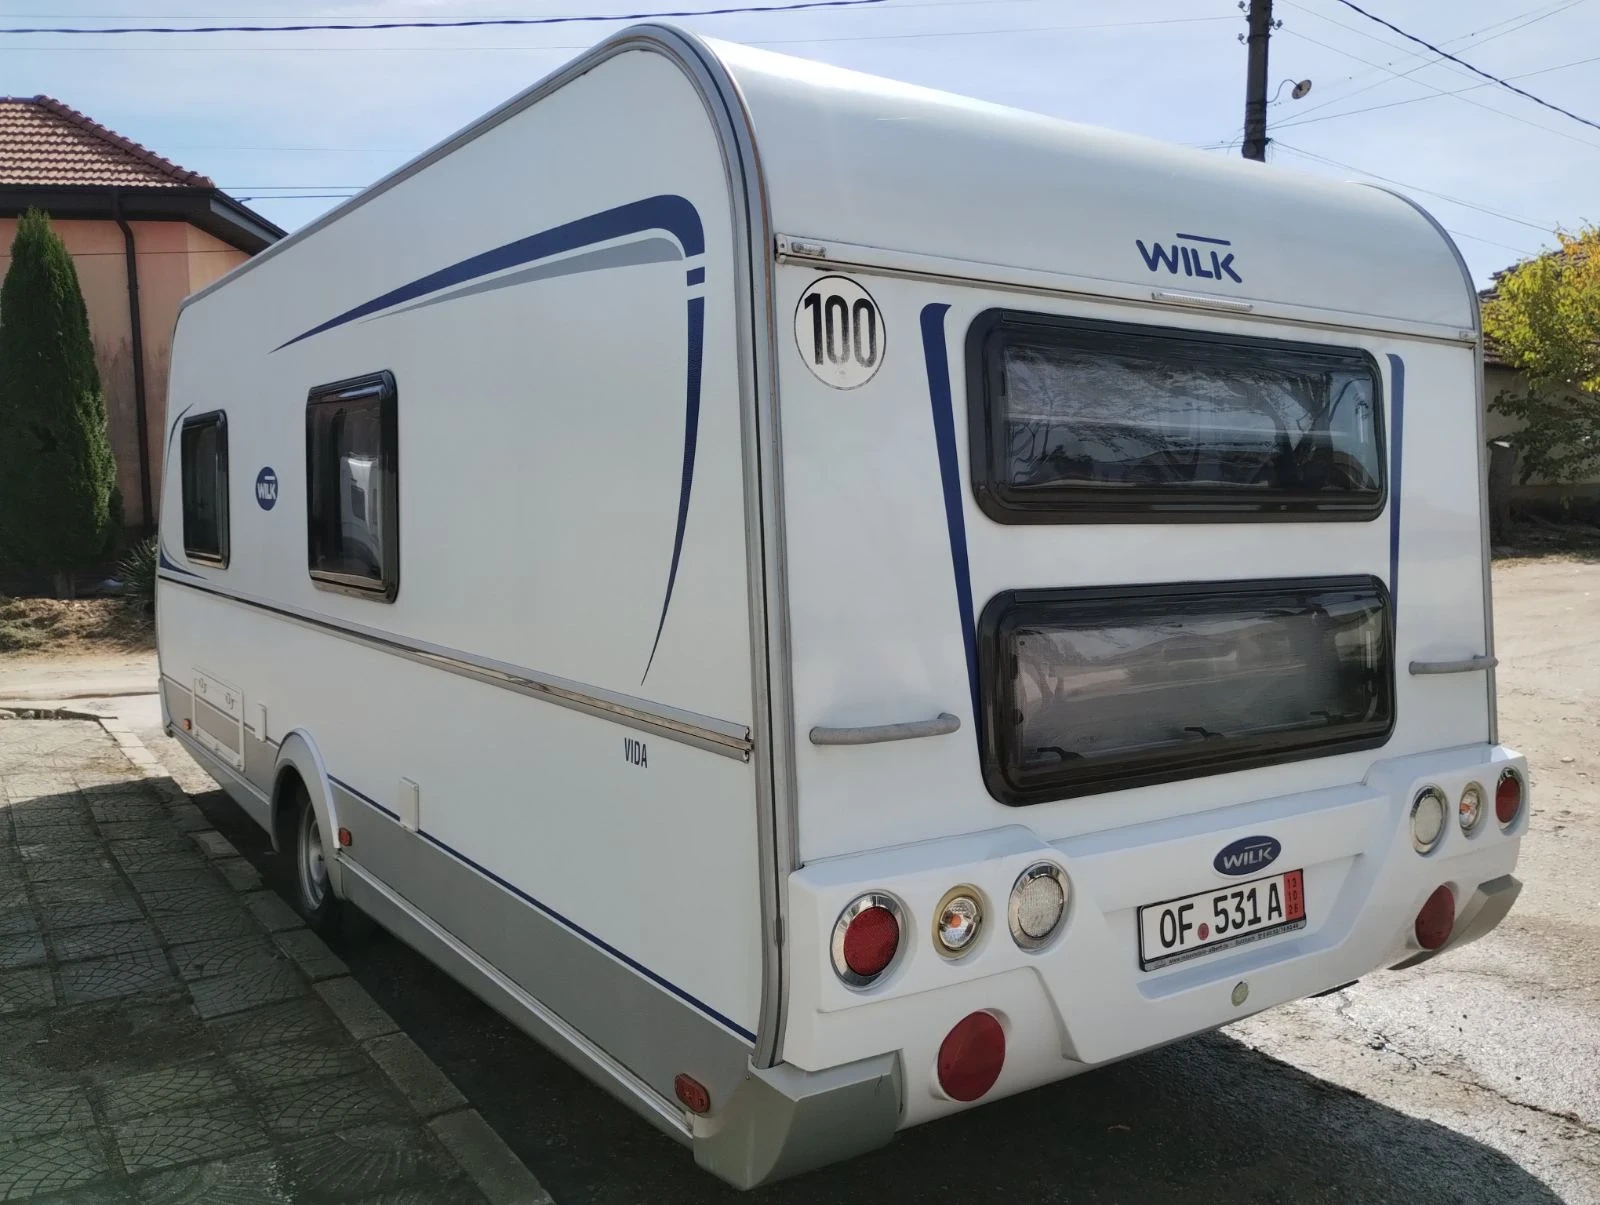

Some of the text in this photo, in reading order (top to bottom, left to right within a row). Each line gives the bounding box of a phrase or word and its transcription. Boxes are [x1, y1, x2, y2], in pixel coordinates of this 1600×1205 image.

[1136, 233, 1242, 283] WILK
[804, 292, 877, 368] 100
[257, 476, 277, 500] WILK
[624, 737, 648, 769] VIDA
[1223, 842, 1273, 870] WILK
[1160, 903, 1194, 948] OF
